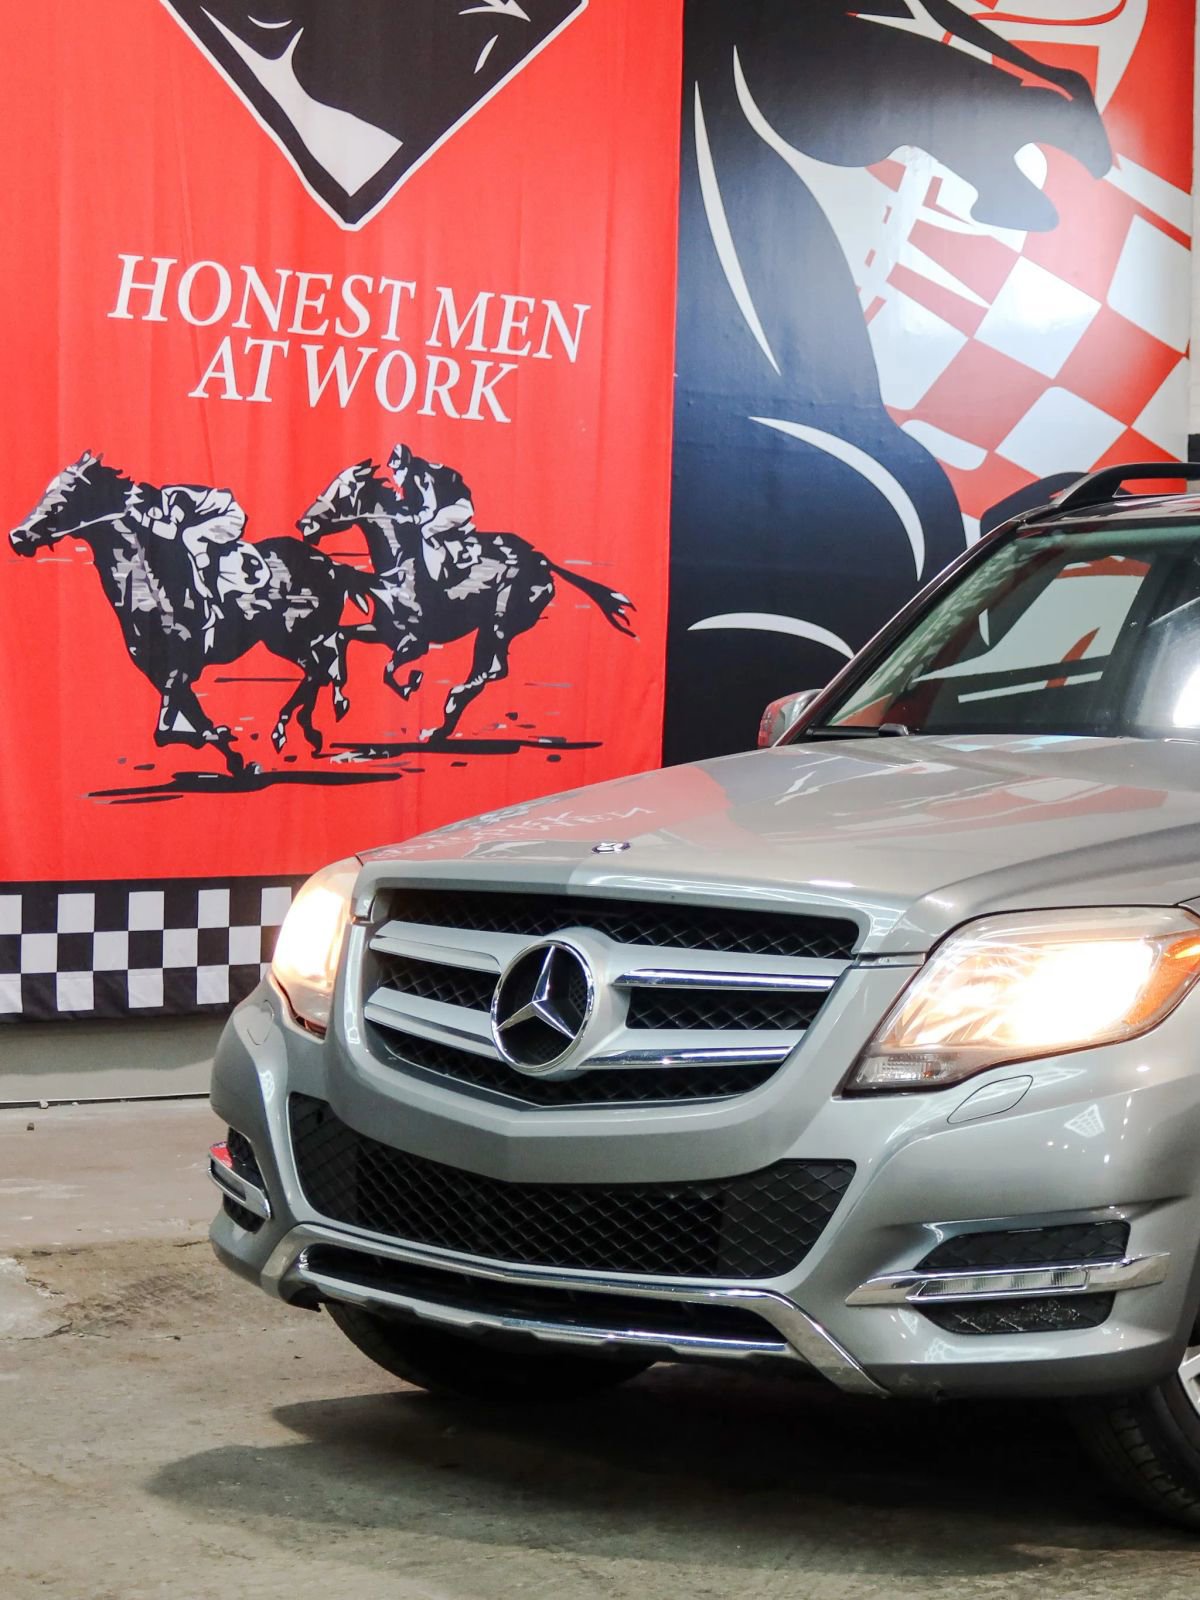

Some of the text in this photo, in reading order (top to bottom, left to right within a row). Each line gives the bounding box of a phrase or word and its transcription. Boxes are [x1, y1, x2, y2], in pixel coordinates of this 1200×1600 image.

[108, 254, 591, 362] HONEST MEN
[188, 336, 518, 423] AT WORK
